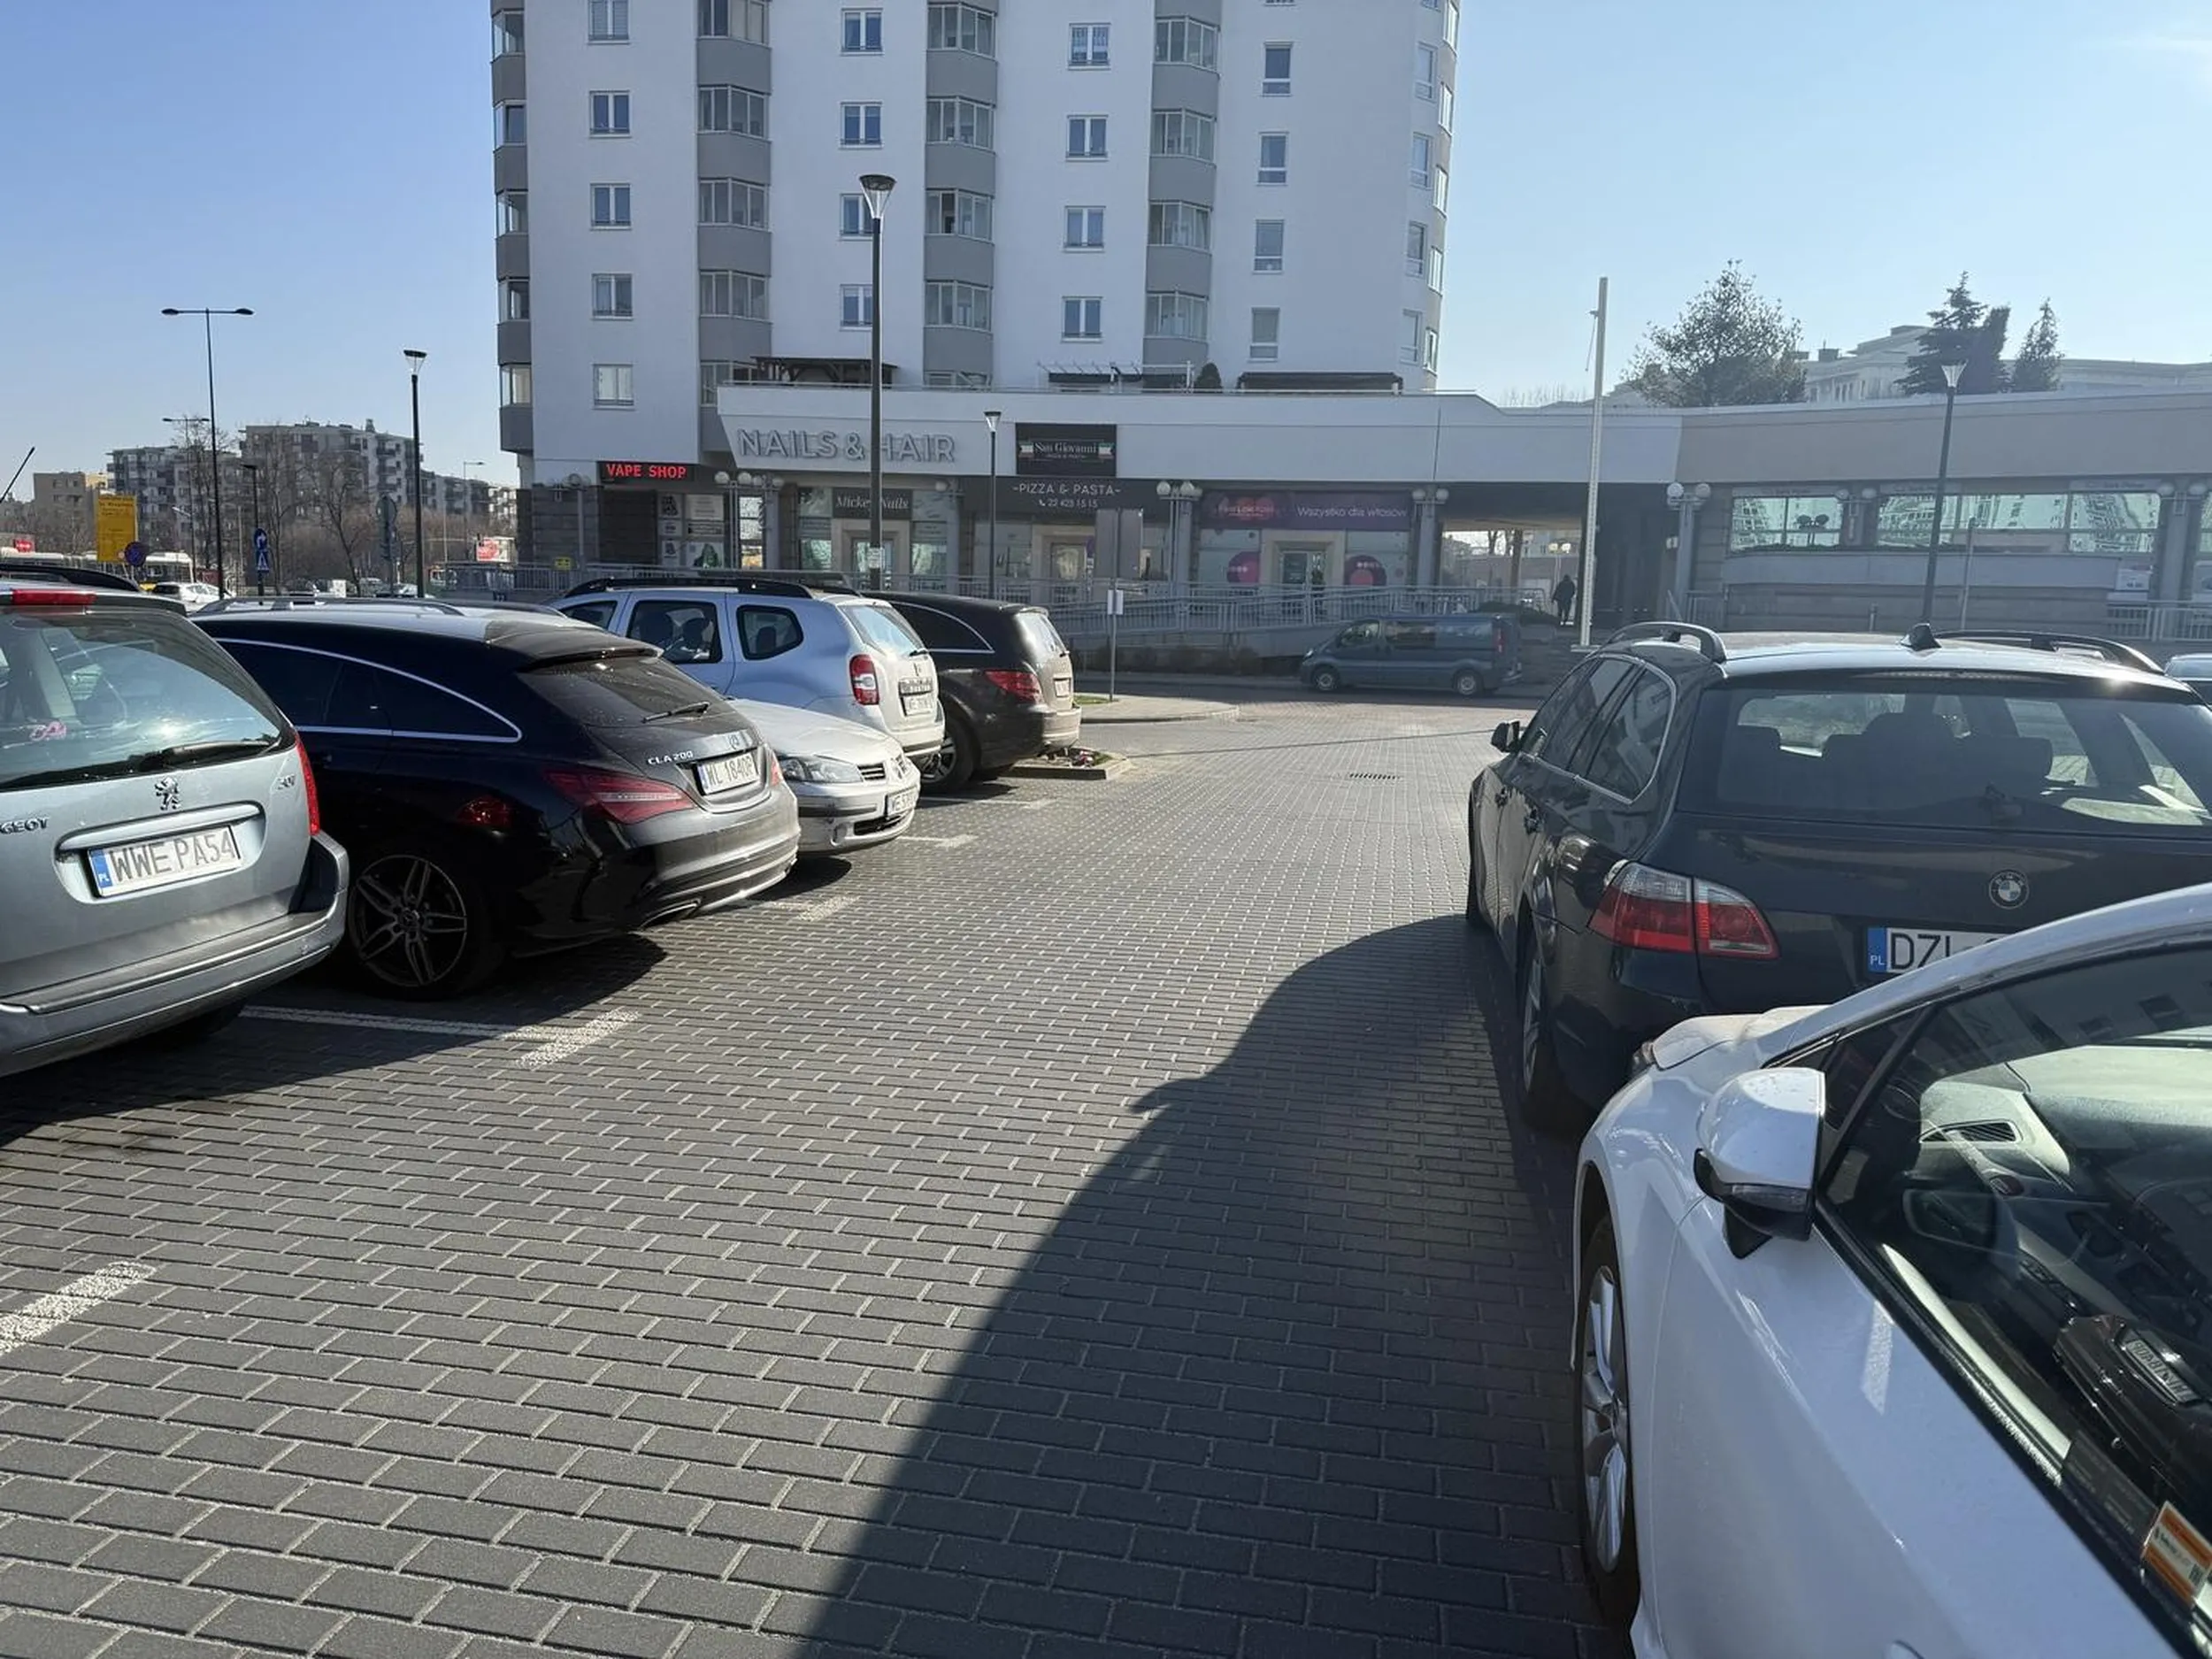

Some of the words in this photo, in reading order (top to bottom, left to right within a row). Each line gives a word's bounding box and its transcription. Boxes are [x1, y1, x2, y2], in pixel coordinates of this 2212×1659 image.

[737, 429, 838, 458] NAILS
[844, 432, 865, 460] &
[606, 464, 641, 478] VAPE
[649, 465, 687, 480] SHOP
[835, 495, 872, 510] Micke
[647, 756, 672, 765] CLA
[672, 750, 694, 761] 200
[110, 842, 173, 883] WWE
[176, 826, 236, 871] PA54
[1870, 955, 1886, 966] PL
